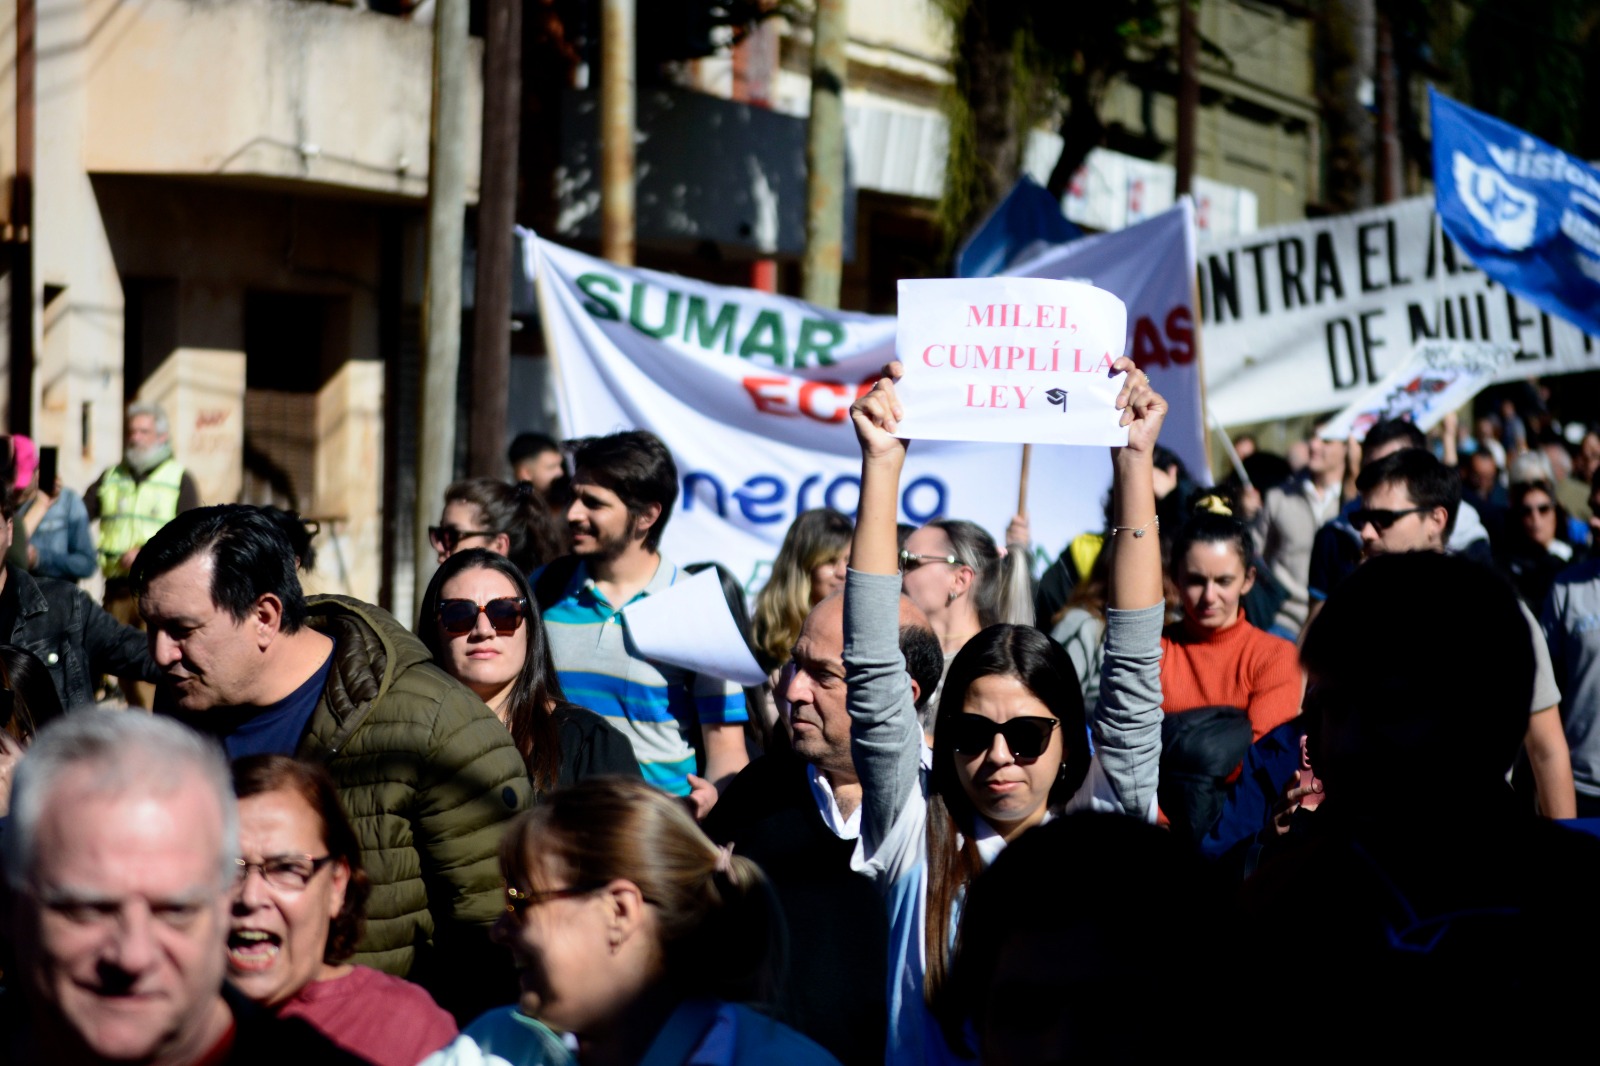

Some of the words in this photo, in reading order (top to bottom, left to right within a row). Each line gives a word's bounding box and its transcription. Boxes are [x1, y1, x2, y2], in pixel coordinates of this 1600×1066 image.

[1357, 217, 1413, 293] EL
[575, 272, 847, 368] SUMAR
[966, 303, 1078, 333] MILEI,
[922, 340, 1060, 373] CUMPLÍ
[1073, 349, 1115, 375] LA
[965, 383, 1035, 410] LEY
